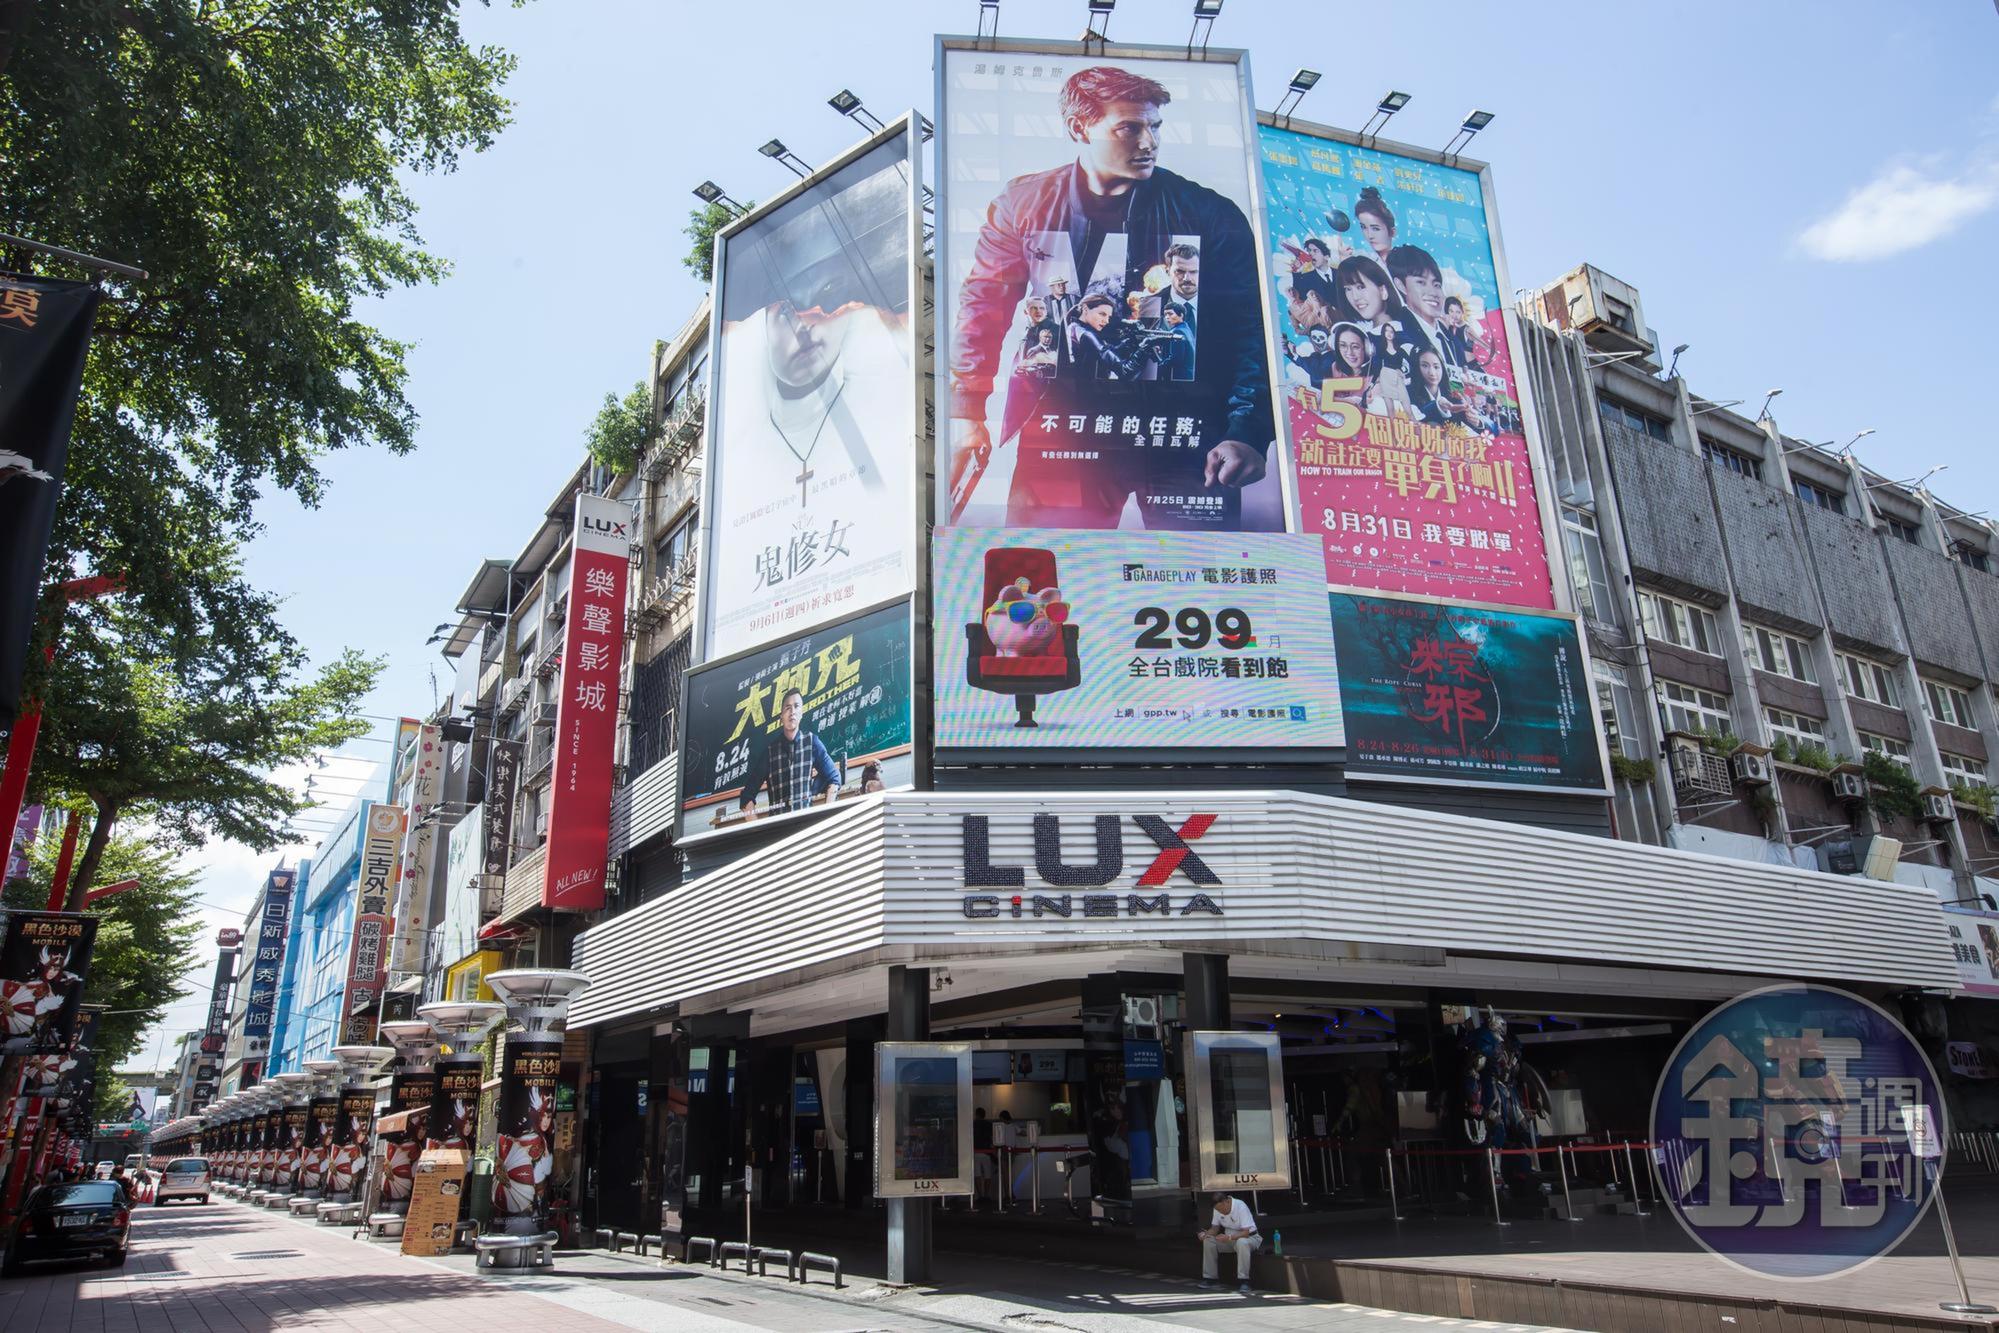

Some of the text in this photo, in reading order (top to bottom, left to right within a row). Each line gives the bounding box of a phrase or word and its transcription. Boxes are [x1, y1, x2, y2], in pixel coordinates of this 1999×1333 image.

[1134, 434, 1200, 448] 全面瓦解
[1300, 466, 1321, 476] HOW
[1321, 467, 1332, 476] TO
[1333, 467, 1352, 476] TRAIN
[1365, 469, 1383, 477] DRAGON
[1146, 495, 1184, 505] 7月25日
[583, 516, 626, 536] LUX
[1323, 508, 1513, 553] 8月31日 我要脫單
[583, 528, 627, 541] CINEMA
[752, 519, 856, 594] 鬼修女
[1133, 567, 1278, 585] GARAGEPLAY 電影護照
[1134, 606, 1252, 650] 299
[574, 567, 615, 713] 樂聲影城
[1128, 656, 1289, 679] 全台戲院看到飽
[1113, 706, 1135, 718] 上網
[1143, 708, 1178, 718] gpp.tw
[714, 738, 750, 774] 8.24
[963, 813, 1223, 887] LUX
[360, 838, 395, 916] 三吉外賣
[556, 878, 570, 892] ALL
[22, 922, 83, 937] 黑色沙漠
[32, 938, 67, 946] MOBILE
[353, 921, 382, 983] 碳烤雞腿
[248, 903, 286, 1026] 日新威秀影城
[443, 1076, 482, 1090] 黑色沙
[399, 1086, 433, 1099] 黑色沙
[914, 1180, 940, 1190] LUX
[1234, 1174, 1259, 1184] LUX
